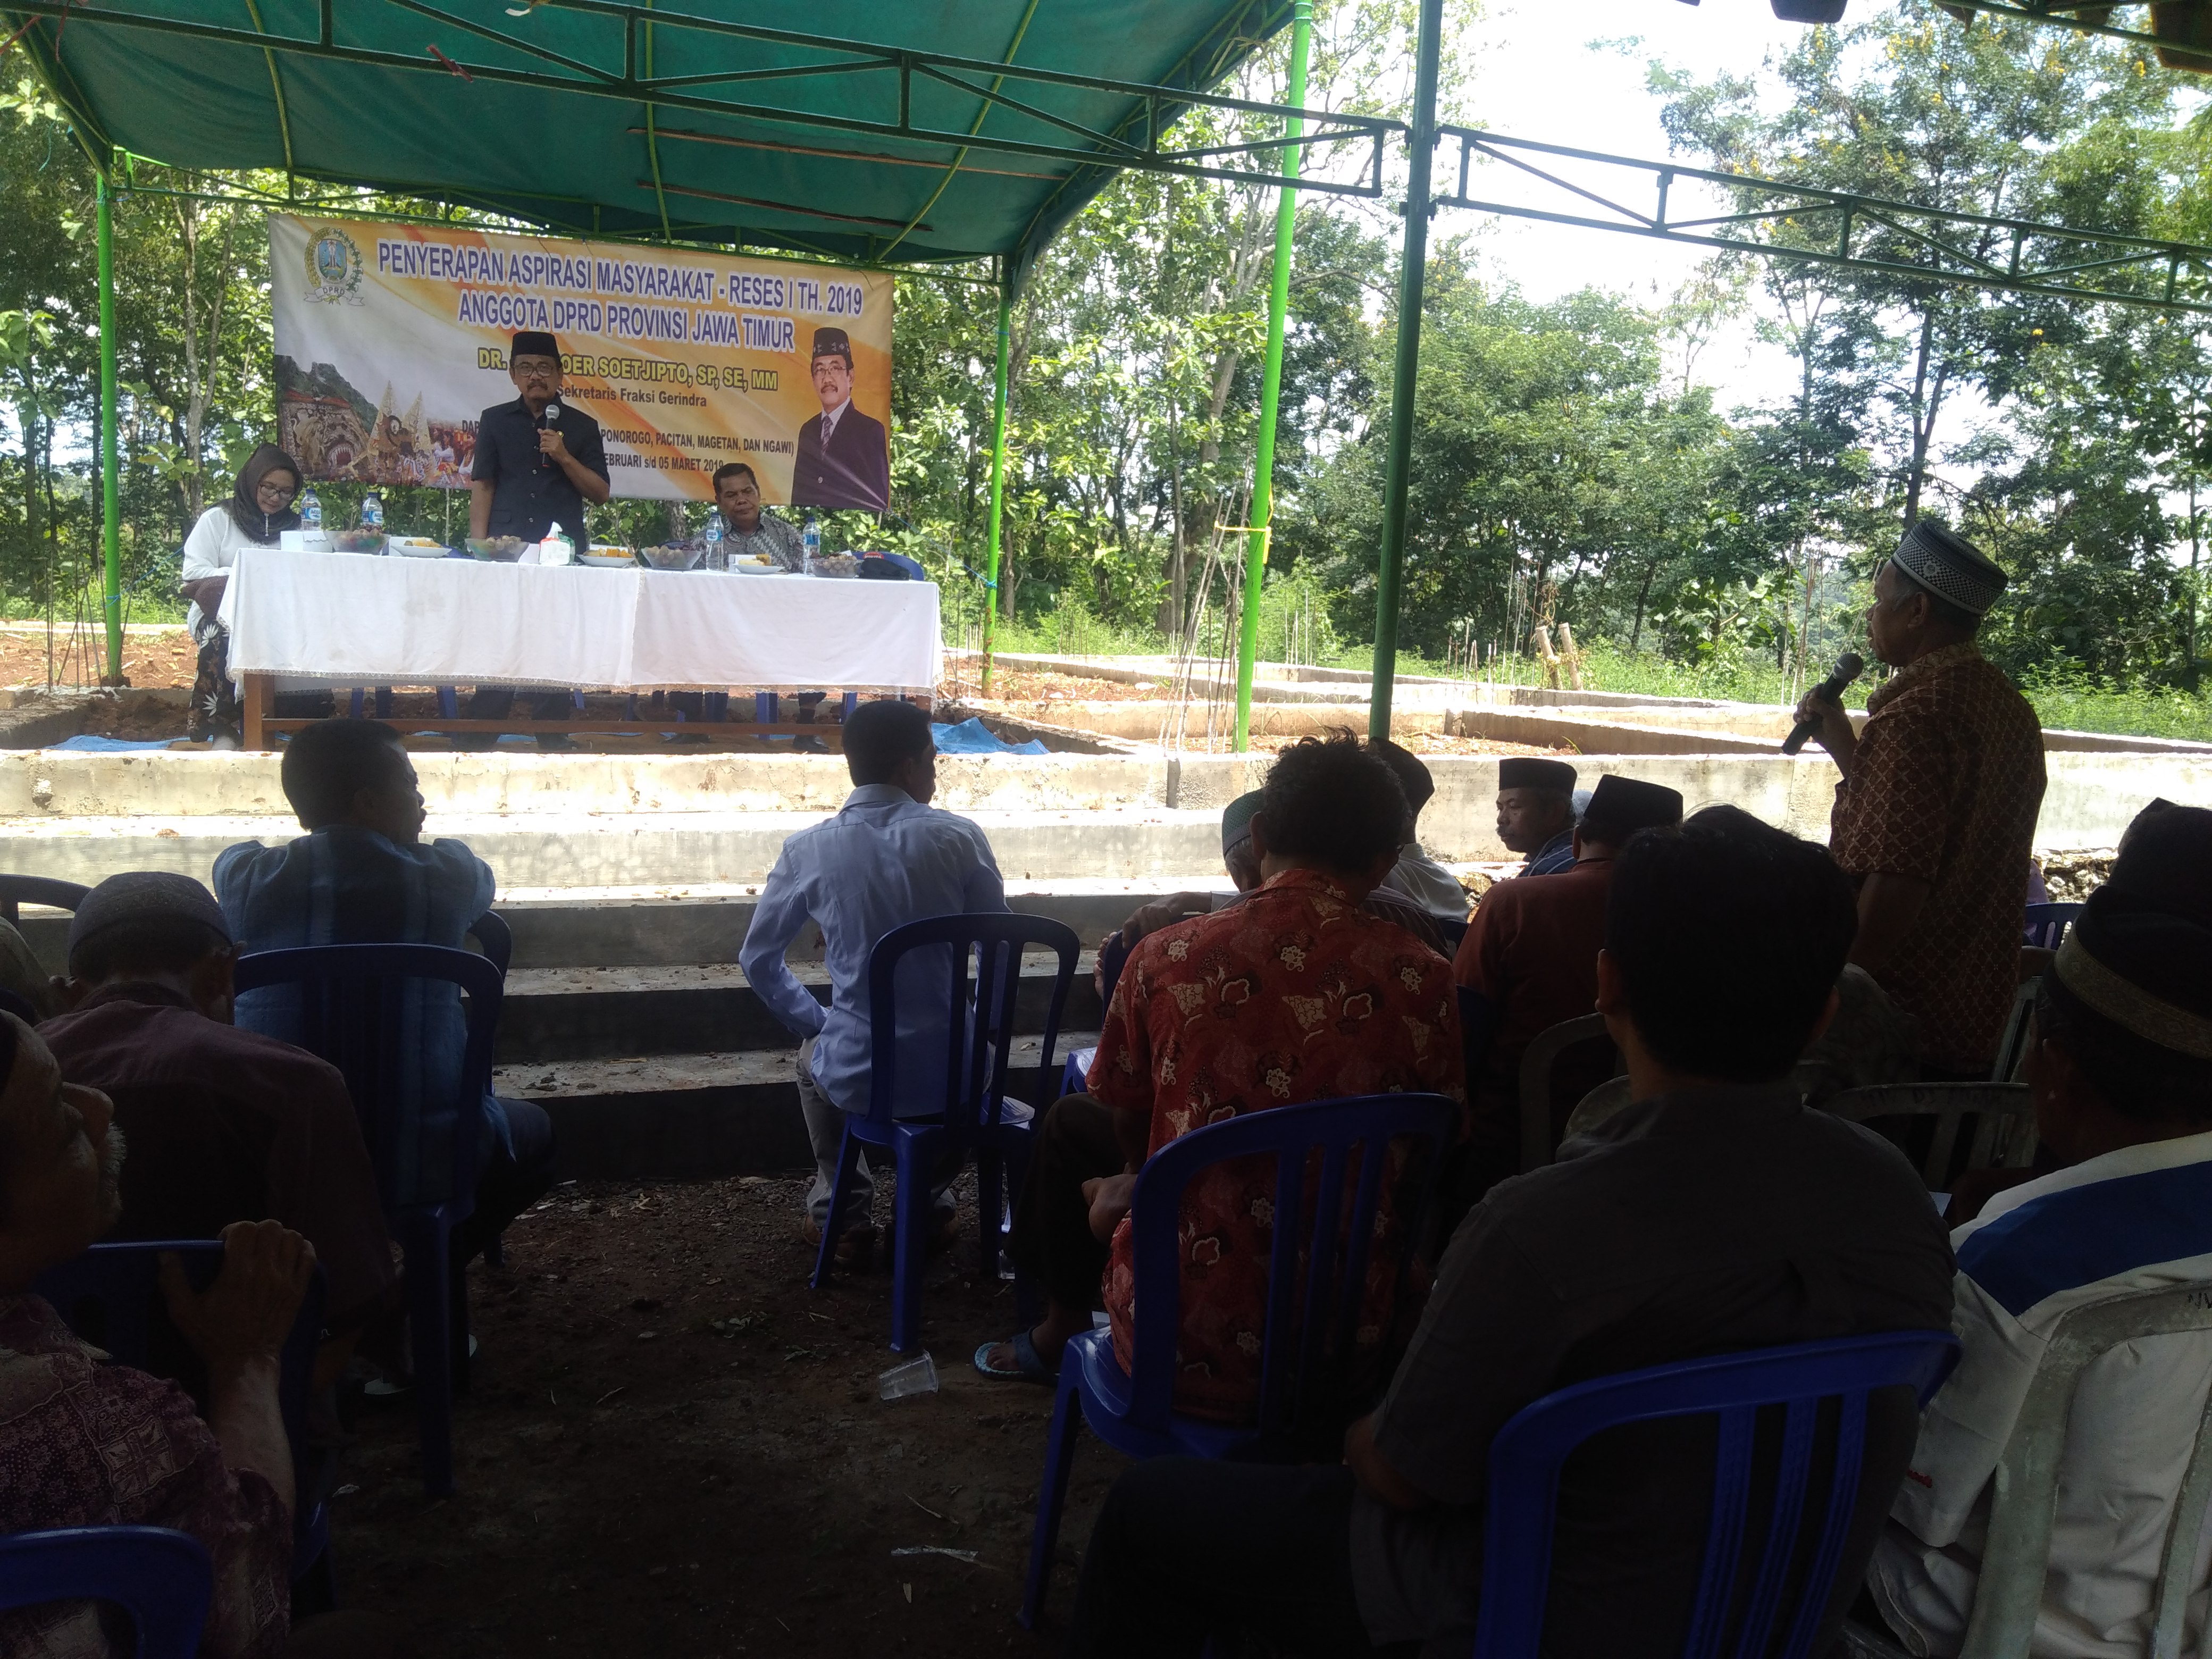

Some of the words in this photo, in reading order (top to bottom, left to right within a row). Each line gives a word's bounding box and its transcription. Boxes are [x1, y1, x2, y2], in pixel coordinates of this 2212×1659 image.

[322, 287, 345, 295] DPRD
[379, 242, 504, 282] PENYERAPAN
[508, 254, 591, 289] ASPIRASI
[597, 262, 715, 300] MASYARAKAT
[730, 275, 784, 307] RESES
[789, 281, 793, 308] I
[798, 282, 822, 311] TH.
[827, 285, 862, 315] 2019
[459, 294, 549, 328] ANGGOTA
[554, 301, 602, 332] DPRD
[607, 305, 688, 339] PROVINSI
[692, 313, 739, 345] JAWA
[742, 318, 793, 349] TIMUR
[477, 347, 508, 371] DR.
[560, 353, 596, 376] OER
[598, 356, 693, 389] SOETJIPTO,
[695, 364, 720, 391] SP,
[722, 366, 748, 393] SE,
[751, 368, 778, 391] MM
[558, 383, 617, 400] Sekretaris
[620, 387, 655, 403] Fraksi
[659, 390, 707, 407] Gerindra
[656, 432, 696, 450] PACITAN,
[698, 435, 741, 453] MAGETAN,
[743, 438, 760, 451] DAN
[763, 439, 794, 457] NGAWI)
[604, 453, 642, 468] EBRUARI
[644, 455, 656, 469] s/d
[659, 456, 669, 470] 05
[672, 456, 701, 471] MARET
